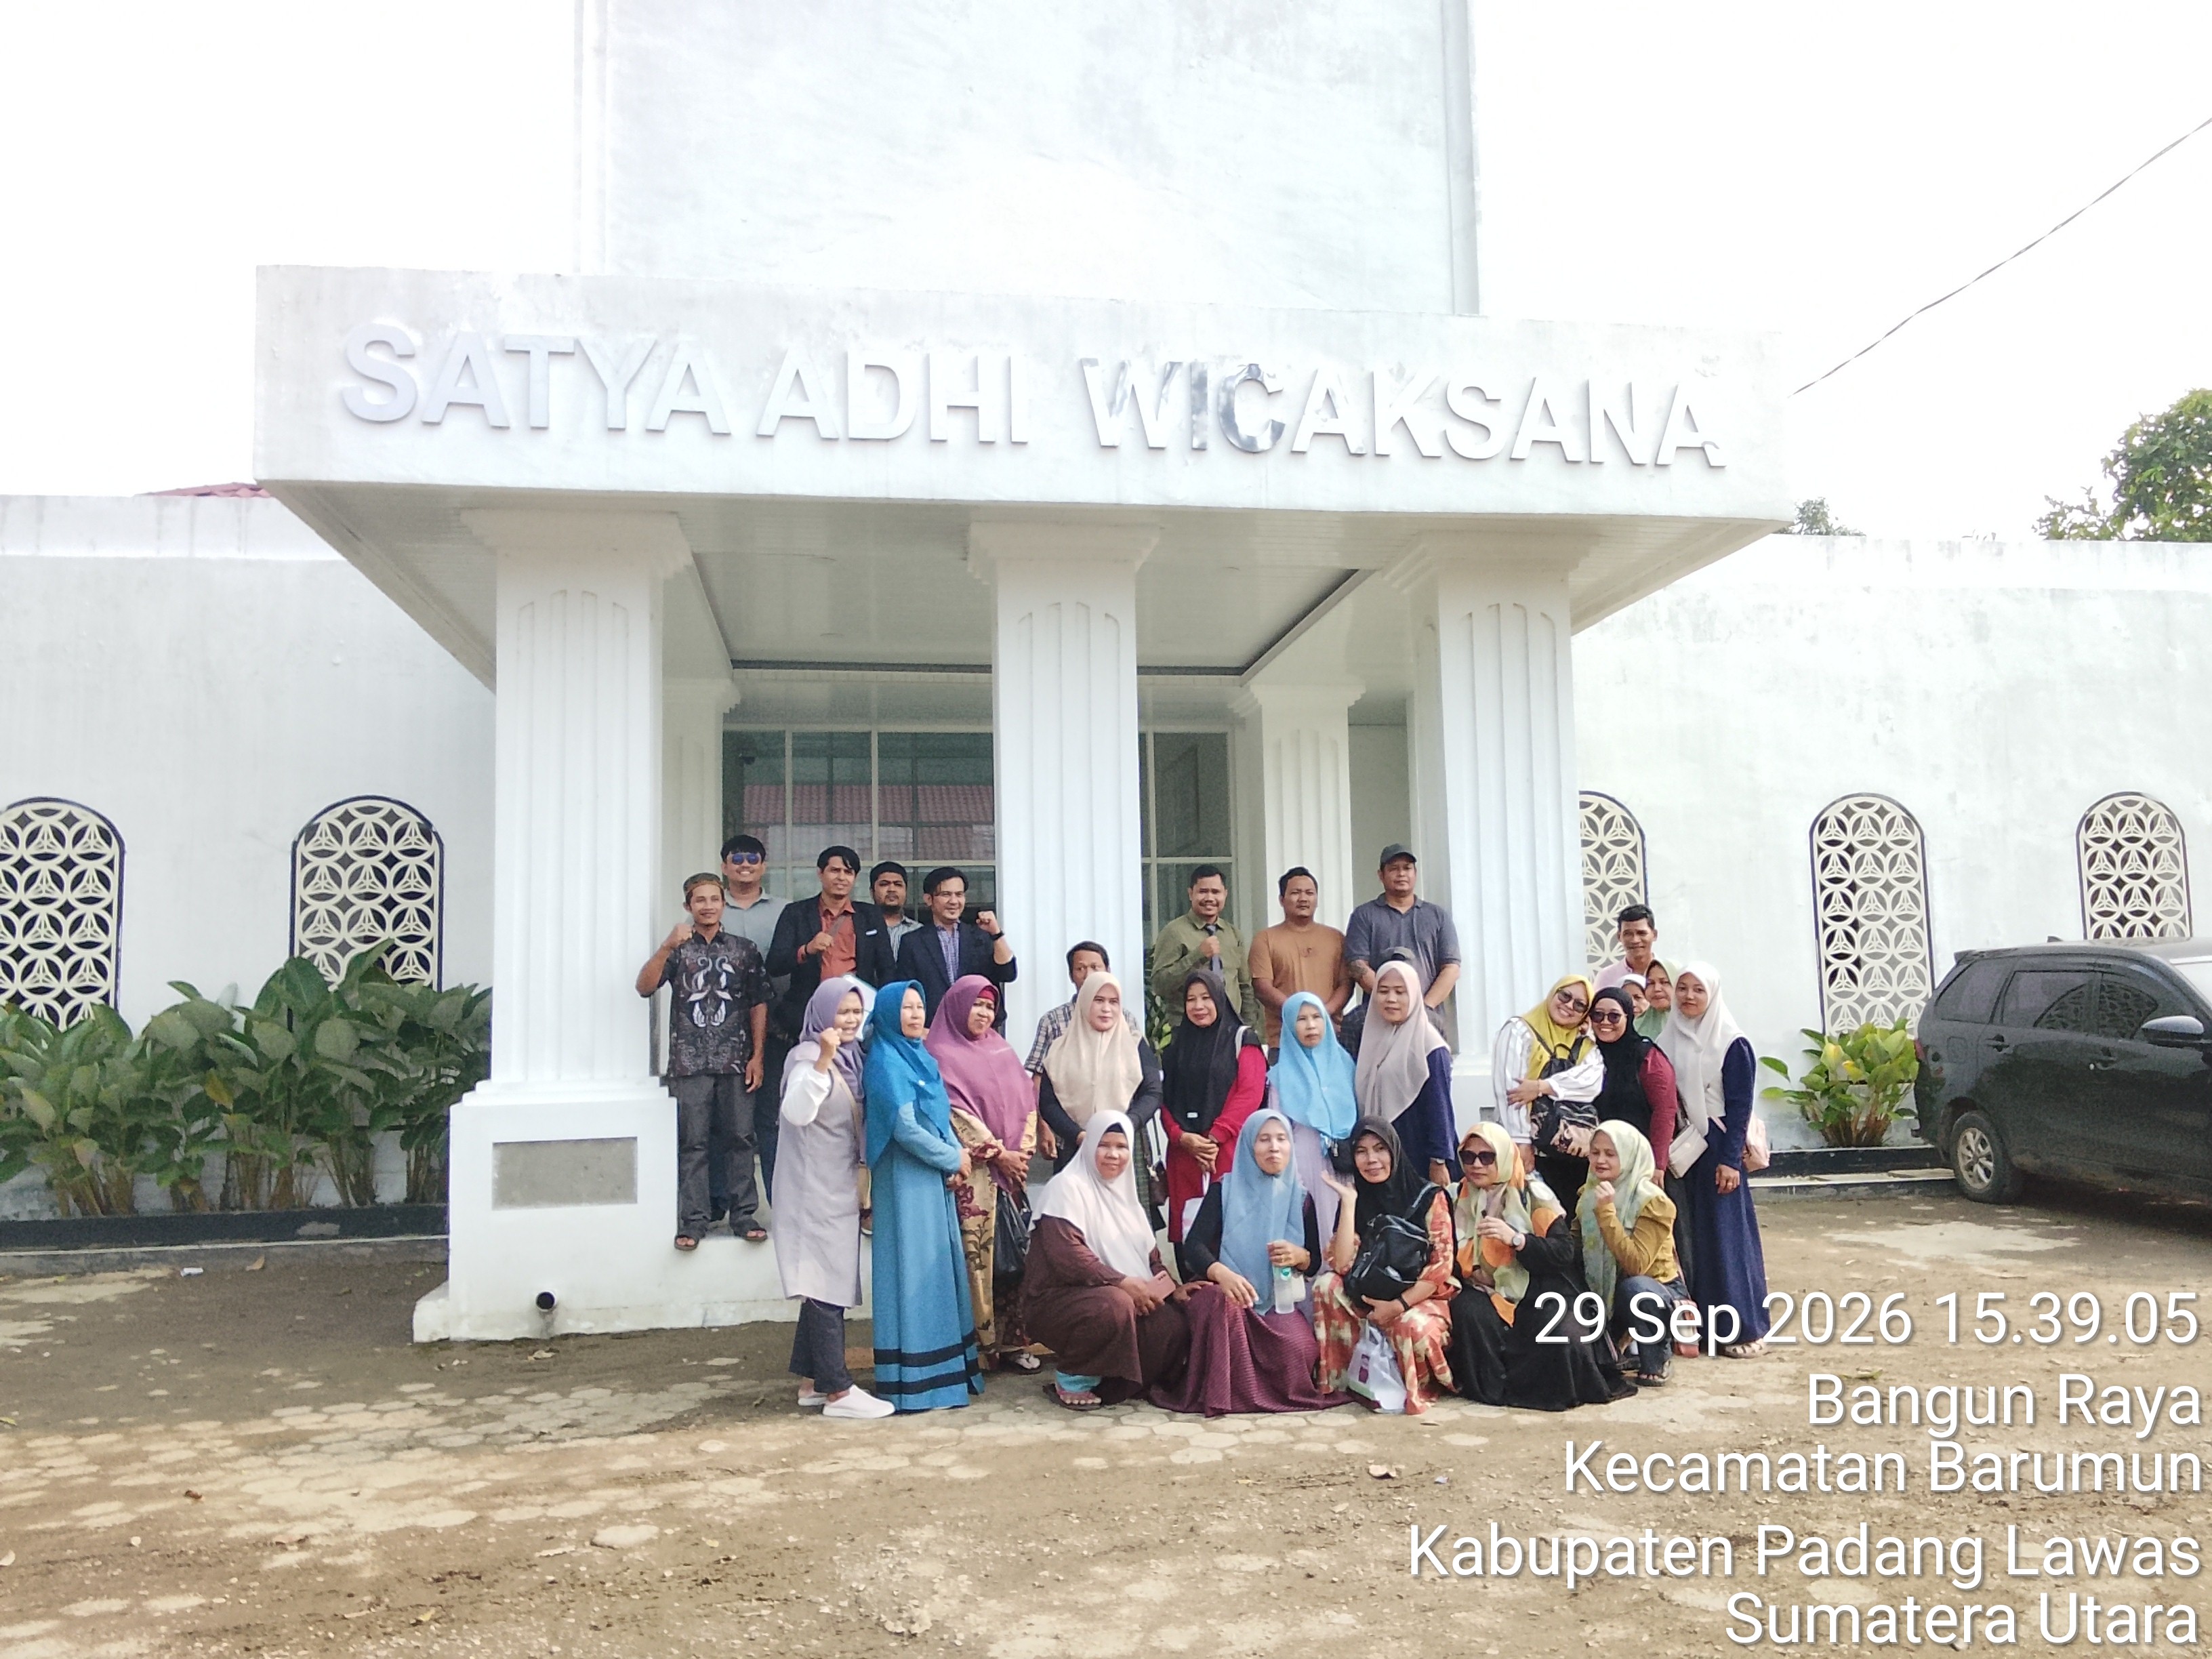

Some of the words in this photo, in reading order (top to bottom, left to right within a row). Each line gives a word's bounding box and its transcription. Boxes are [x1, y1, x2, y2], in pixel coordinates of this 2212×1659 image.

[343, 325, 731, 435] SATYA
[757, 348, 1029, 445] ADHI
[1081, 358, 1726, 468] WICAKSANA
